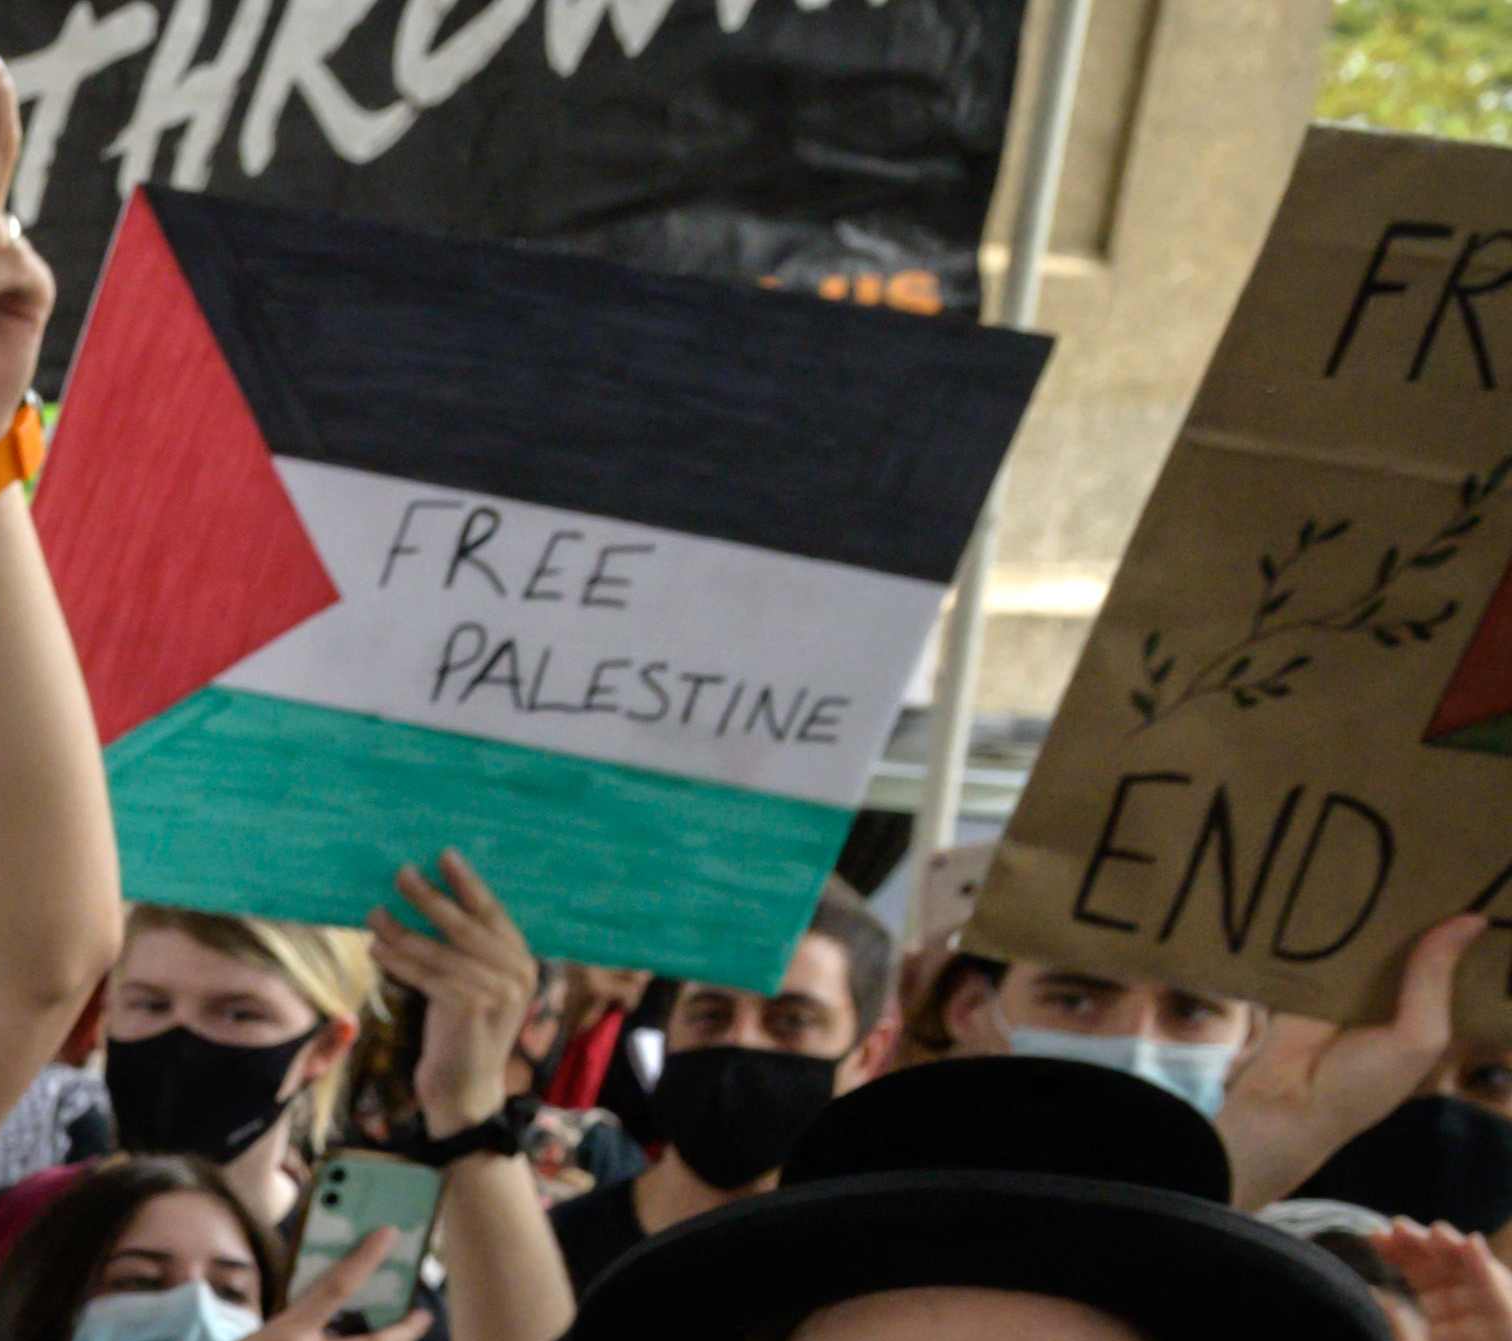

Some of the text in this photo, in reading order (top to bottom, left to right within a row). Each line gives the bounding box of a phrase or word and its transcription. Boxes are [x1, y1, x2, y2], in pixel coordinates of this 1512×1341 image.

[376, 496, 659, 613] FREE
[430, 622, 854, 748] PALESTINE
[1072, 771, 1397, 962] END
